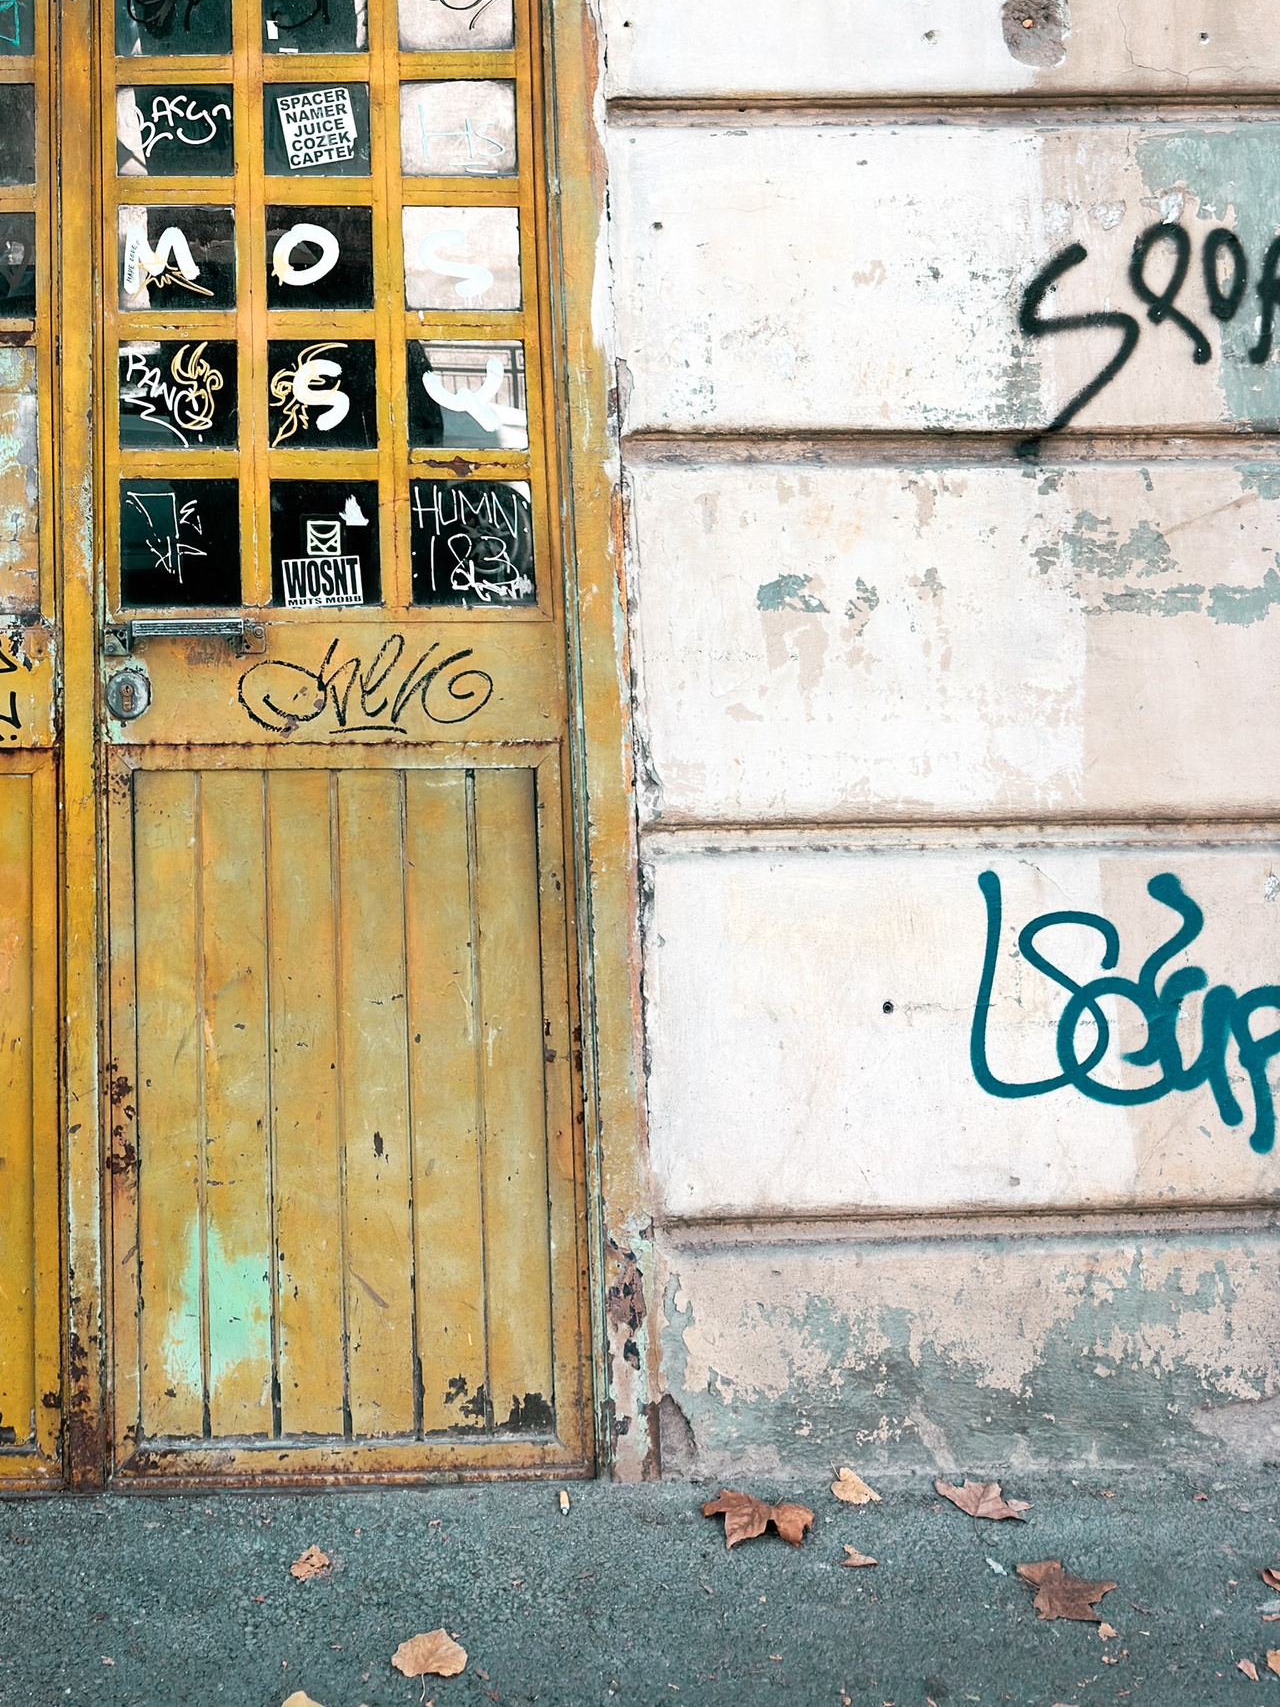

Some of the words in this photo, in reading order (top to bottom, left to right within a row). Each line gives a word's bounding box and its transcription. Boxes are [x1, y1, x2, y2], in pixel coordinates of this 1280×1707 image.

[279, 89, 347, 111] SPACER
[285, 103, 348, 124] NAMER
[293, 118, 345, 138] JUICE
[291, 131, 351, 152] COZEK
[284, 557, 359, 599] WOSNT
[288, 597, 322, 606] MUTS
[326, 595, 362, 604] MOBB
